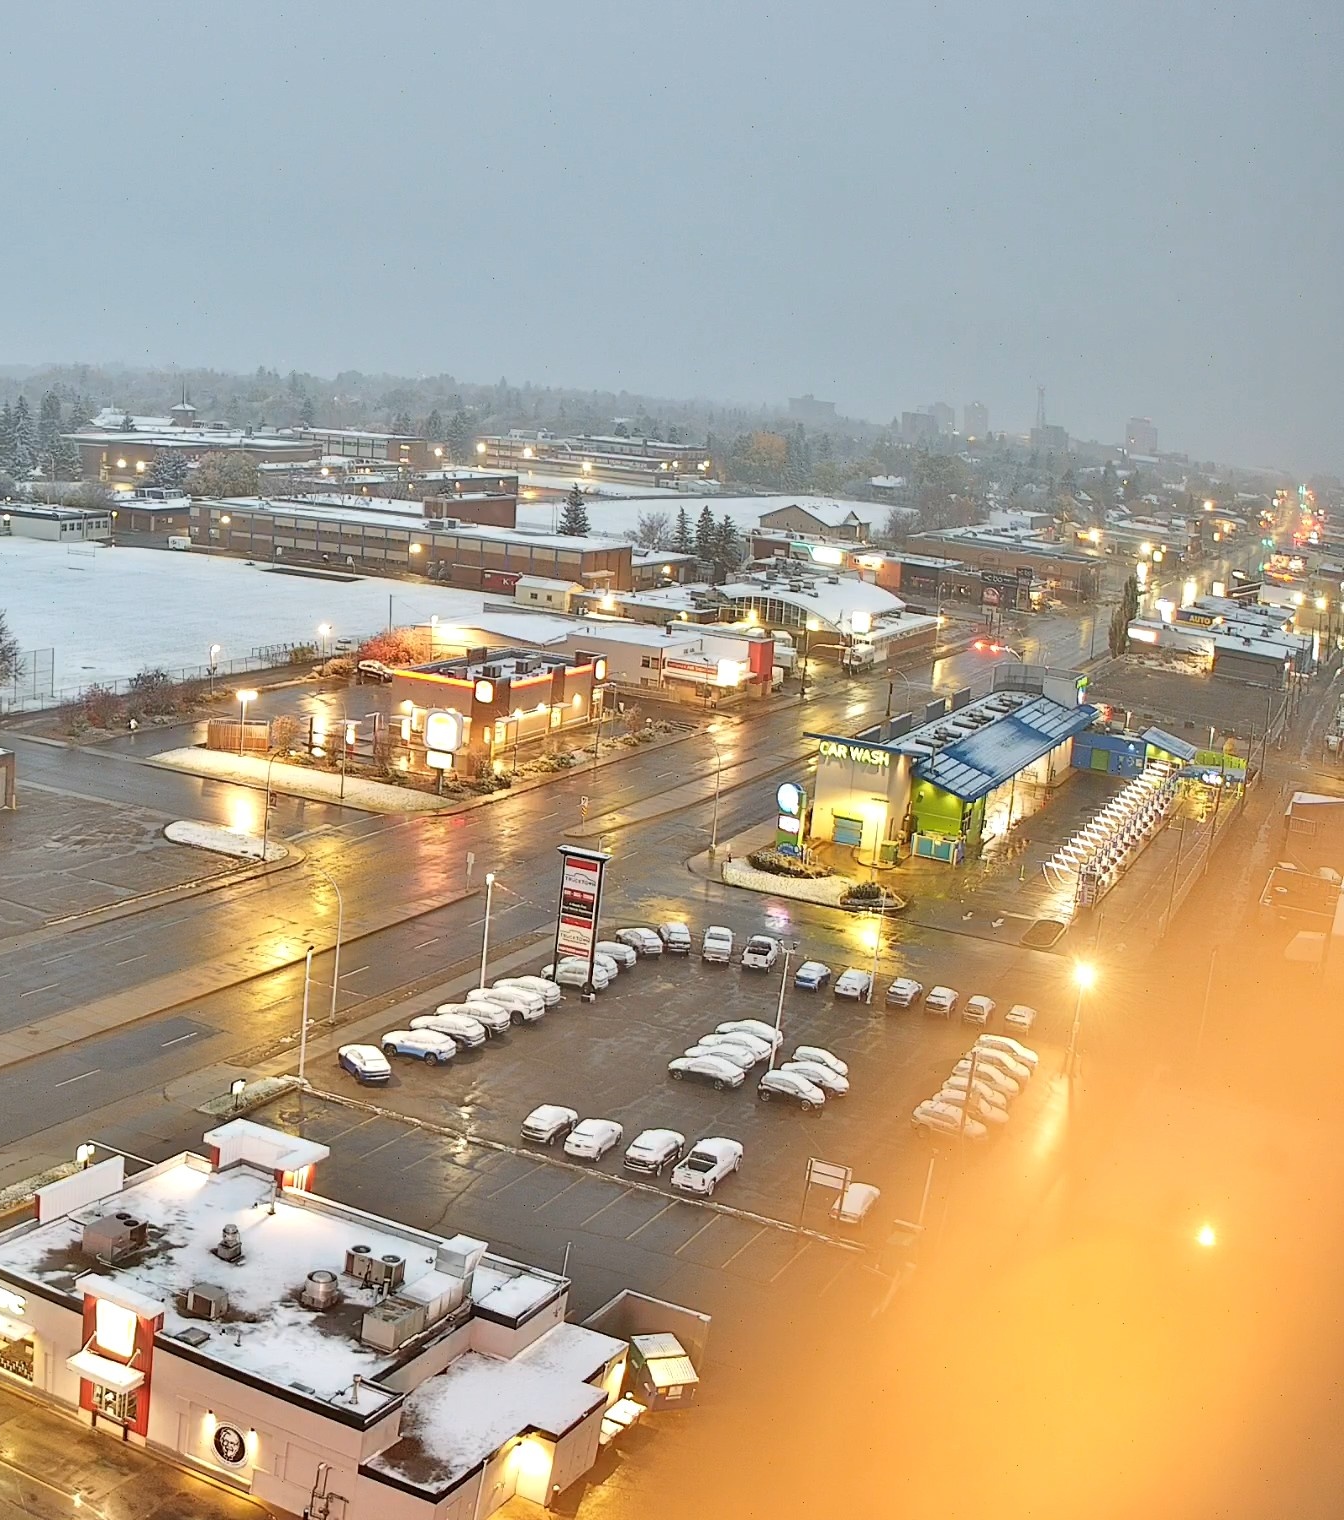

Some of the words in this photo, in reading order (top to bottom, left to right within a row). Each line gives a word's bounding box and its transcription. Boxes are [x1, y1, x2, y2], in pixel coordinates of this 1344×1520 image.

[1189, 615, 1212, 625] AUTO
[819, 741, 848, 759] CAR
[849, 746, 890, 766] WASH
